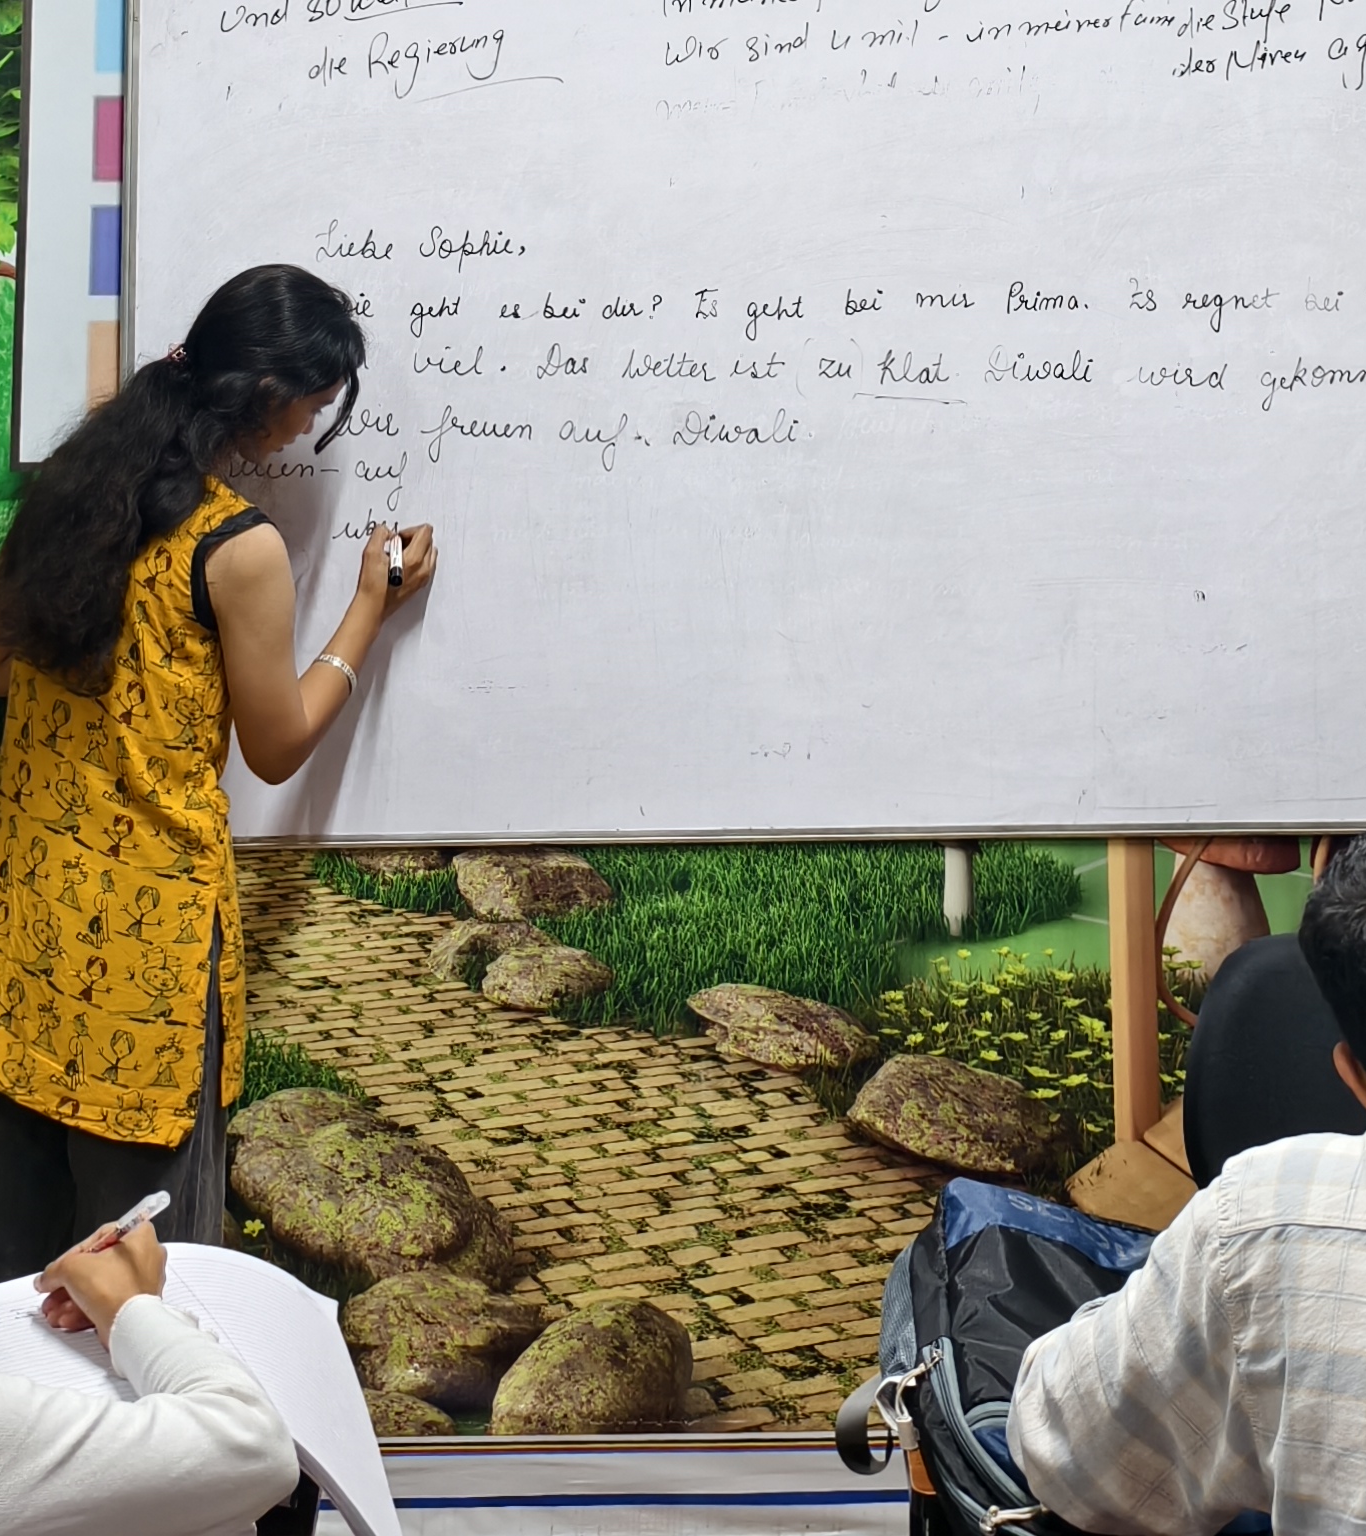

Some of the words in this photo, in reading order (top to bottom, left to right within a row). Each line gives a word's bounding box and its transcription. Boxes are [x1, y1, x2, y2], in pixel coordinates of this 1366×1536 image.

[316, 218, 393, 262] Liebe
[411, 297, 460, 337] geht
[746, 297, 804, 340] geht
[845, 289, 883, 317] bei
[916, 291, 975, 309] mir
[1183, 290, 1279, 332] regnet
[536, 343, 589, 379] Das
[731, 355, 784, 380] ist
[1136, 363, 1227, 390] wird
